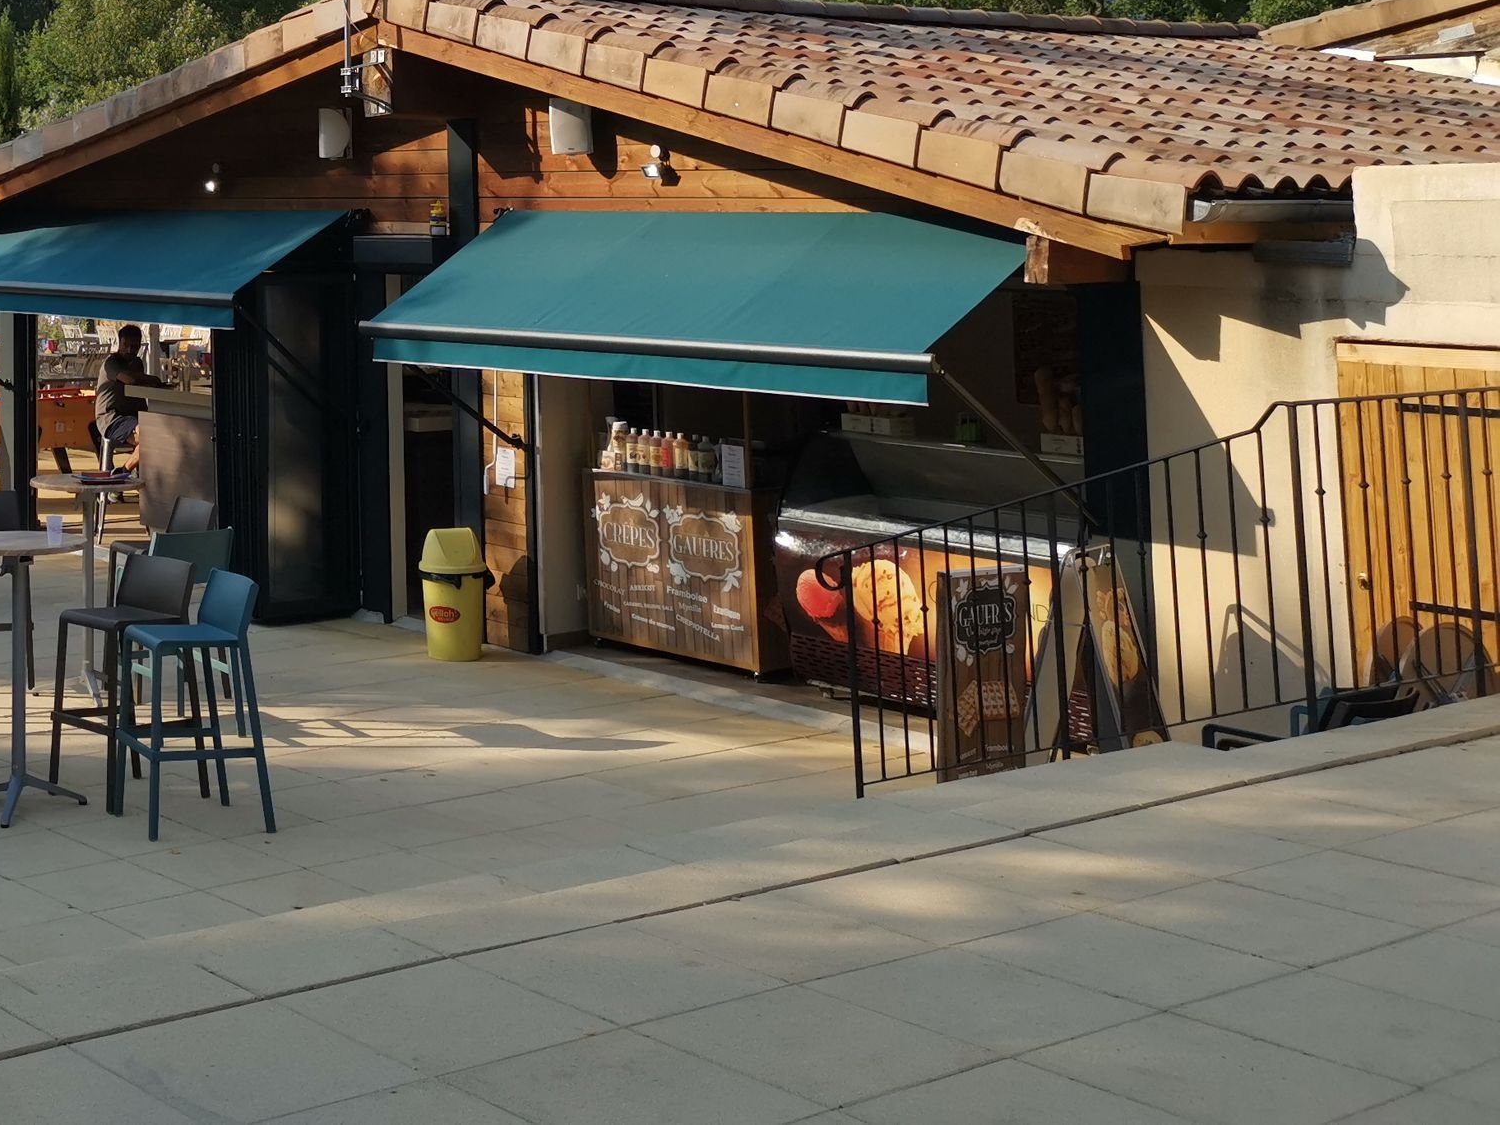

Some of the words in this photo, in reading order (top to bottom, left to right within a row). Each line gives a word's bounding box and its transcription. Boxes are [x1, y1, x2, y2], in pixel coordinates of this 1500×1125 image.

[603, 520, 655, 549] CRÊPES
[673, 534, 734, 562] GAUFRES
[666, 584, 708, 604] Framboise
[959, 602, 1012, 628] GAUFRS
